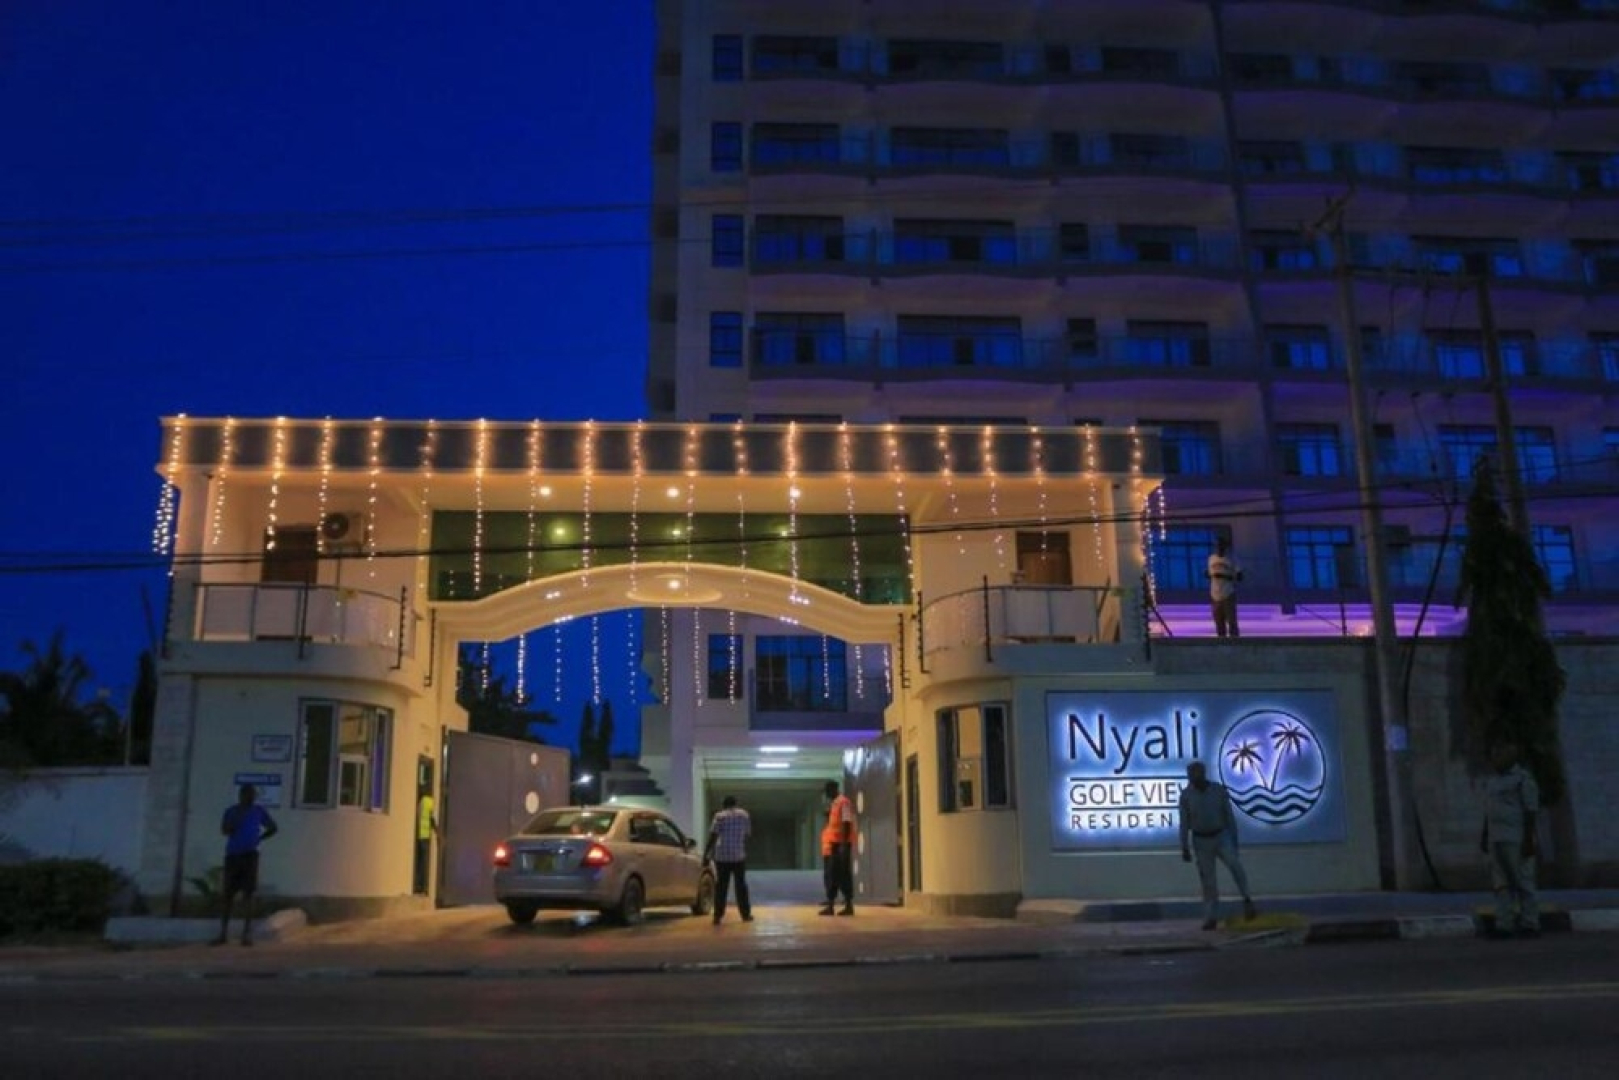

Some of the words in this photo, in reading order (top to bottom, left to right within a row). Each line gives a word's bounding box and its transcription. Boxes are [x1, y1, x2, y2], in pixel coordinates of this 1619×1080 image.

[1069, 711, 1199, 775] Nyali
[1071, 783, 1134, 806] GOLF
[1073, 813, 1173, 830] RESIDEN
